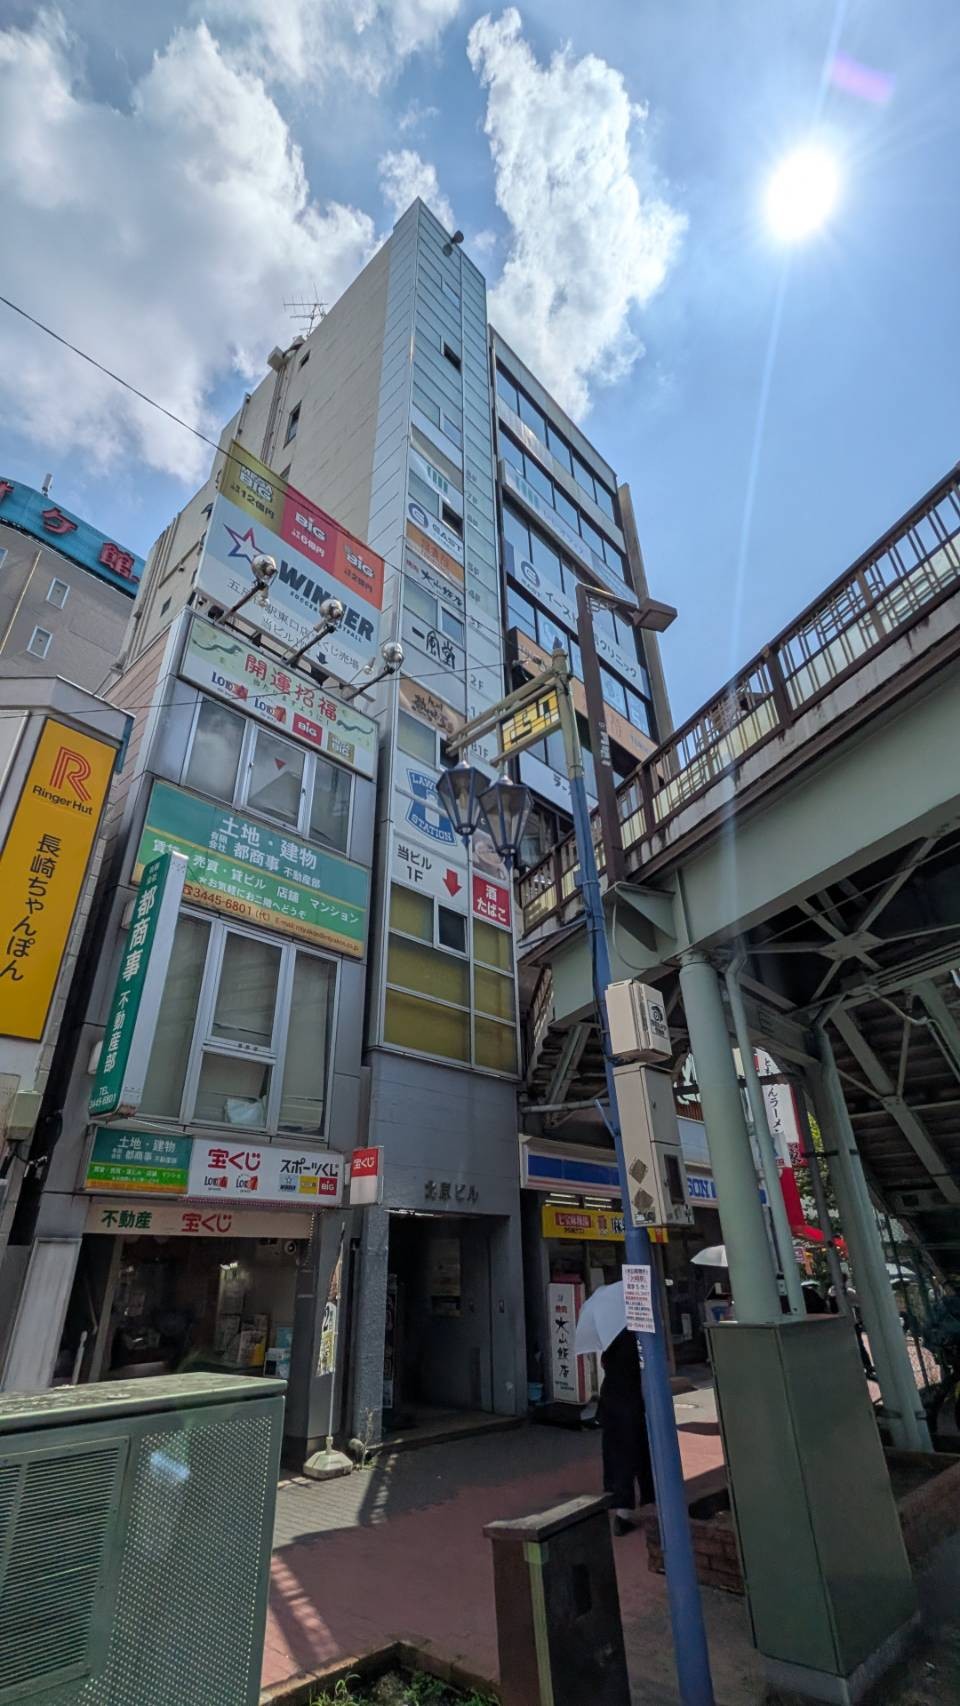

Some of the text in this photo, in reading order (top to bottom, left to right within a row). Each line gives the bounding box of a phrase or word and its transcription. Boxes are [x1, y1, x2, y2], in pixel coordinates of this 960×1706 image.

[294, 511, 328, 541] BIG
[345, 551, 375, 579] BIG
[278, 559, 375, 642] WINER
[411, 626, 456, 670] 一風堂
[244, 653, 338, 722] 開運招福
[297, 719, 318, 738] BIG
[33, 785, 93, 815] Ringer Hut
[411, 814, 454, 842] STATION
[218, 816, 318, 871] 土地・建物
[233, 842, 280, 872] 都商事
[397, 844, 433, 871] 当ビル
[405, 866, 425, 883] 1F
[276, 885, 300, 905] 店舗
[310, 896, 360, 924] マンション
[486, 885, 497, 902] 酒
[0, 834, 62, 982] 長崎ちゃんぽん
[476, 895, 508, 923] たばこ
[121, 885, 155, 982] 都商事
[117, 1135, 177, 1154] 土地・建物
[208, 1148, 262, 1172] 宝くじ
[280, 1157, 339, 1177] スポーツくじ
[353, 1157, 376, 1170] 宝くじ
[321, 1181, 335, 1192] BIG
[101, 1209, 153, 1230] 不動産
[181, 1212, 233, 1234] 宝くじ
